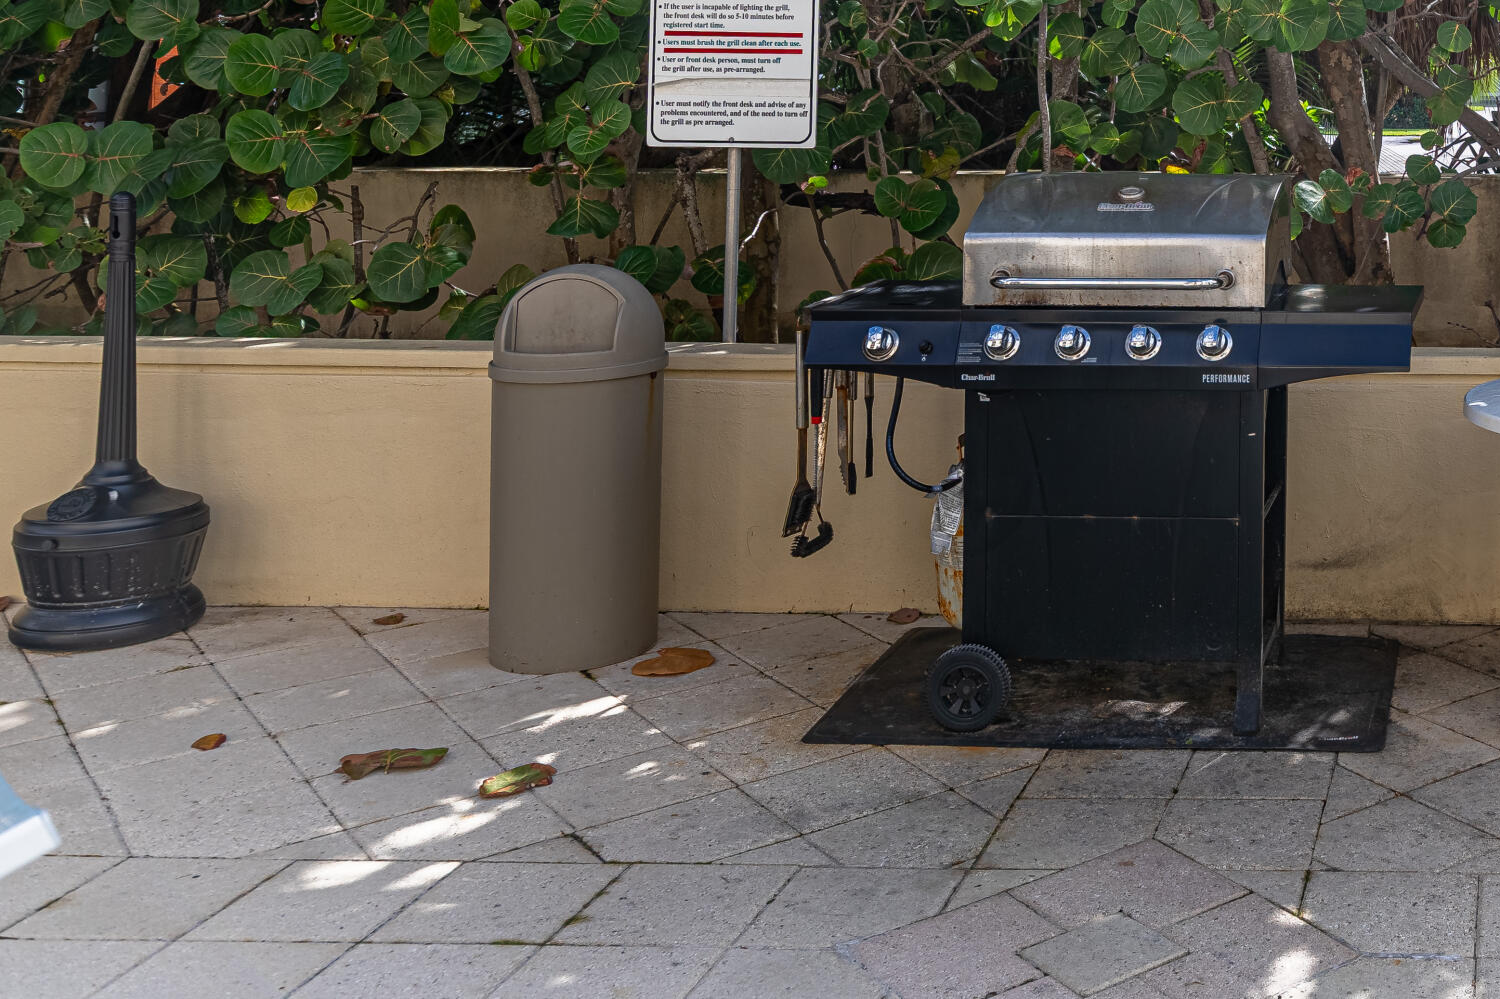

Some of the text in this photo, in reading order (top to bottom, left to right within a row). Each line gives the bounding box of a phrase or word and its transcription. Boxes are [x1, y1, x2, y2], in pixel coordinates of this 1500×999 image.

[702, 4, 731, 12] incapable
[740, 4, 763, 12] lighting
[775, 5, 790, 13] grill,
[674, 12, 689, 20] front
[750, 13, 774, 21] minutes
[663, 22, 693, 30] registered
[727, 40, 740, 48] grill
[772, 57, 781, 65] off
[672, 66, 685, 74] grill
[724, 66, 765, 74] pre-arranged.
[692, 100, 710, 108] notify
[712, 100, 721, 108] the
[767, 101, 787, 109] advise
[660, 110, 689, 118] problems
[690, 110, 729, 118] encountered,
[750, 110, 760, 118] the
[761, 110, 776, 118] need
[671, 119, 684, 127] grill
[705, 119, 735, 127] arranged.
[1202, 374, 1250, 384] PERFORMANCE
